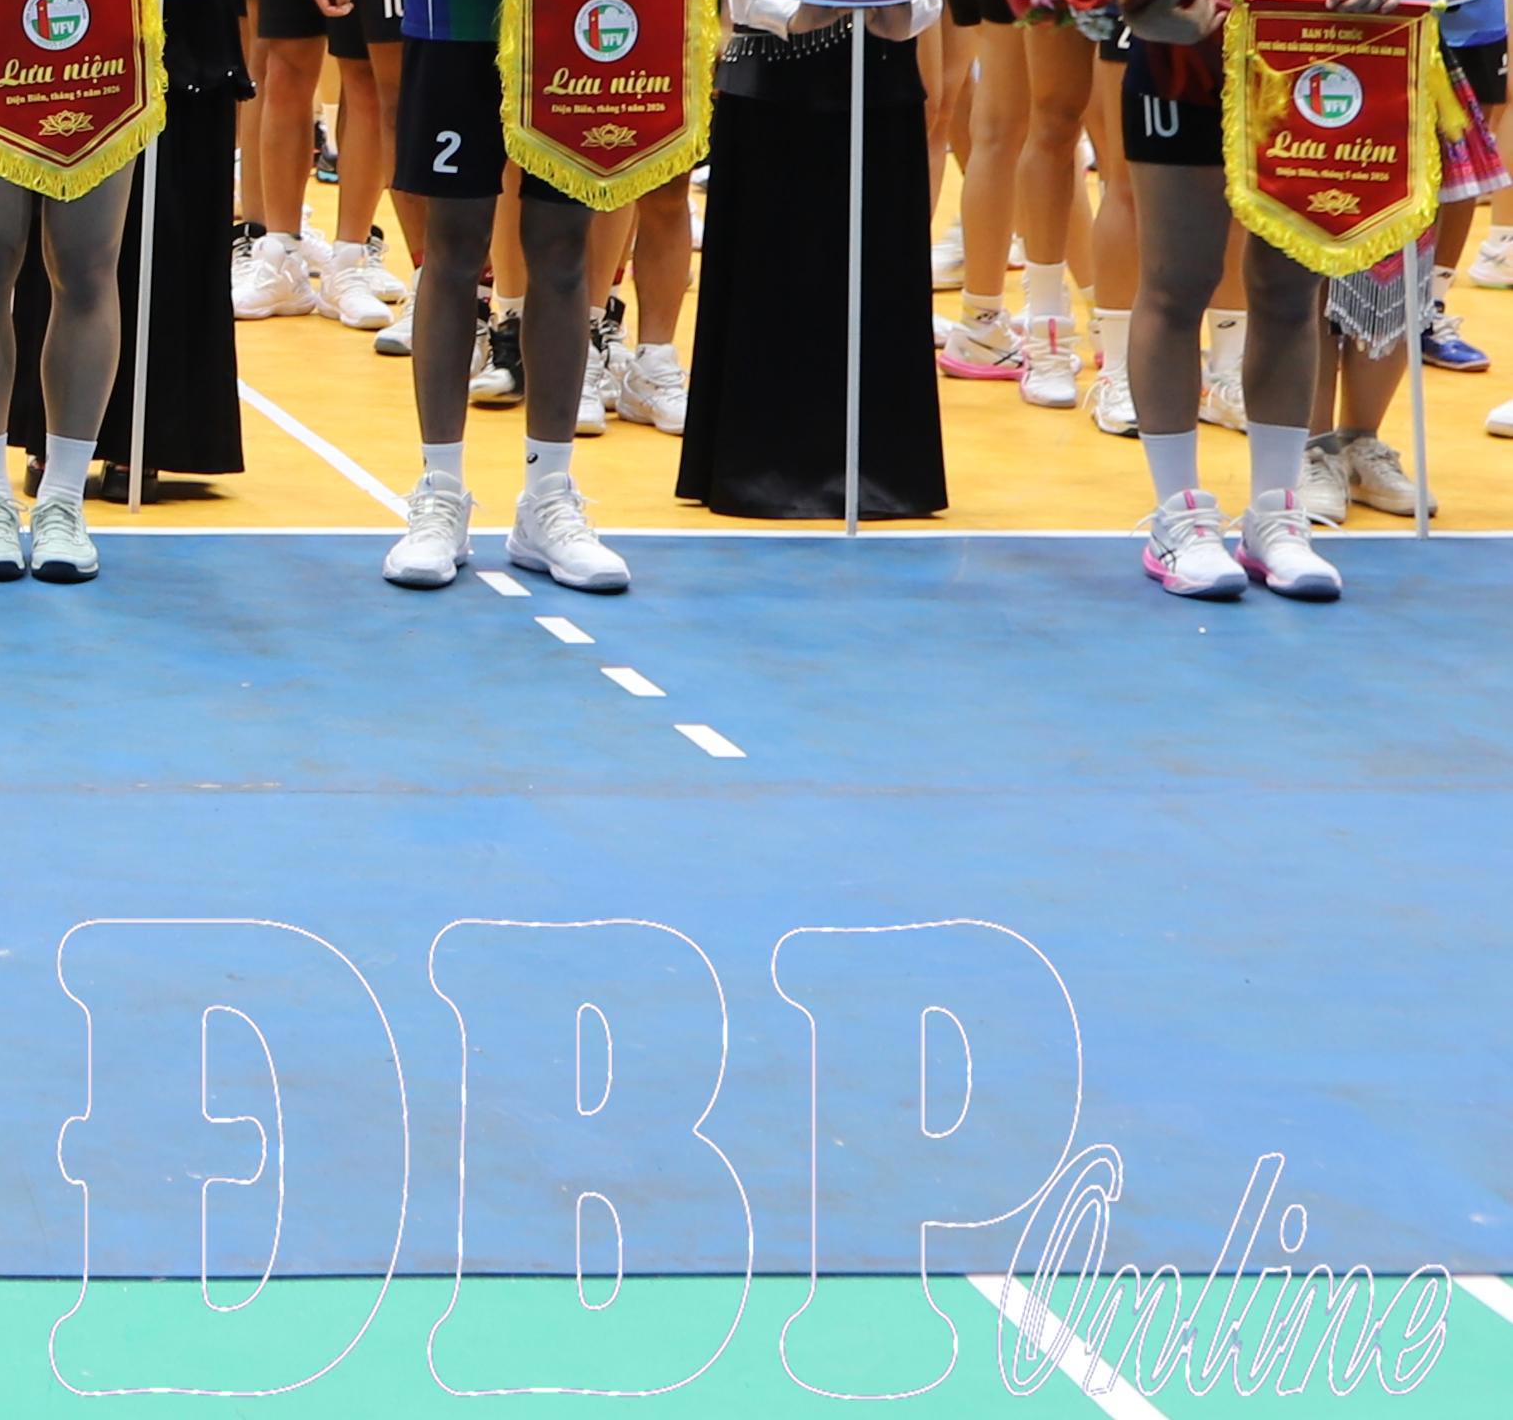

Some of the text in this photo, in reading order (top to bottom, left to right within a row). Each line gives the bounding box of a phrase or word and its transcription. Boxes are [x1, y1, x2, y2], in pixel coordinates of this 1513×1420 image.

[51, 20, 74, 35] VFV
[602, 33, 624, 47] VFV
[64, 55, 125, 83] niệm
[543, 68, 672, 99] Lưu niệm
[433, 130, 462, 173] 2
[1266, 130, 1397, 168] Lưu niệm
